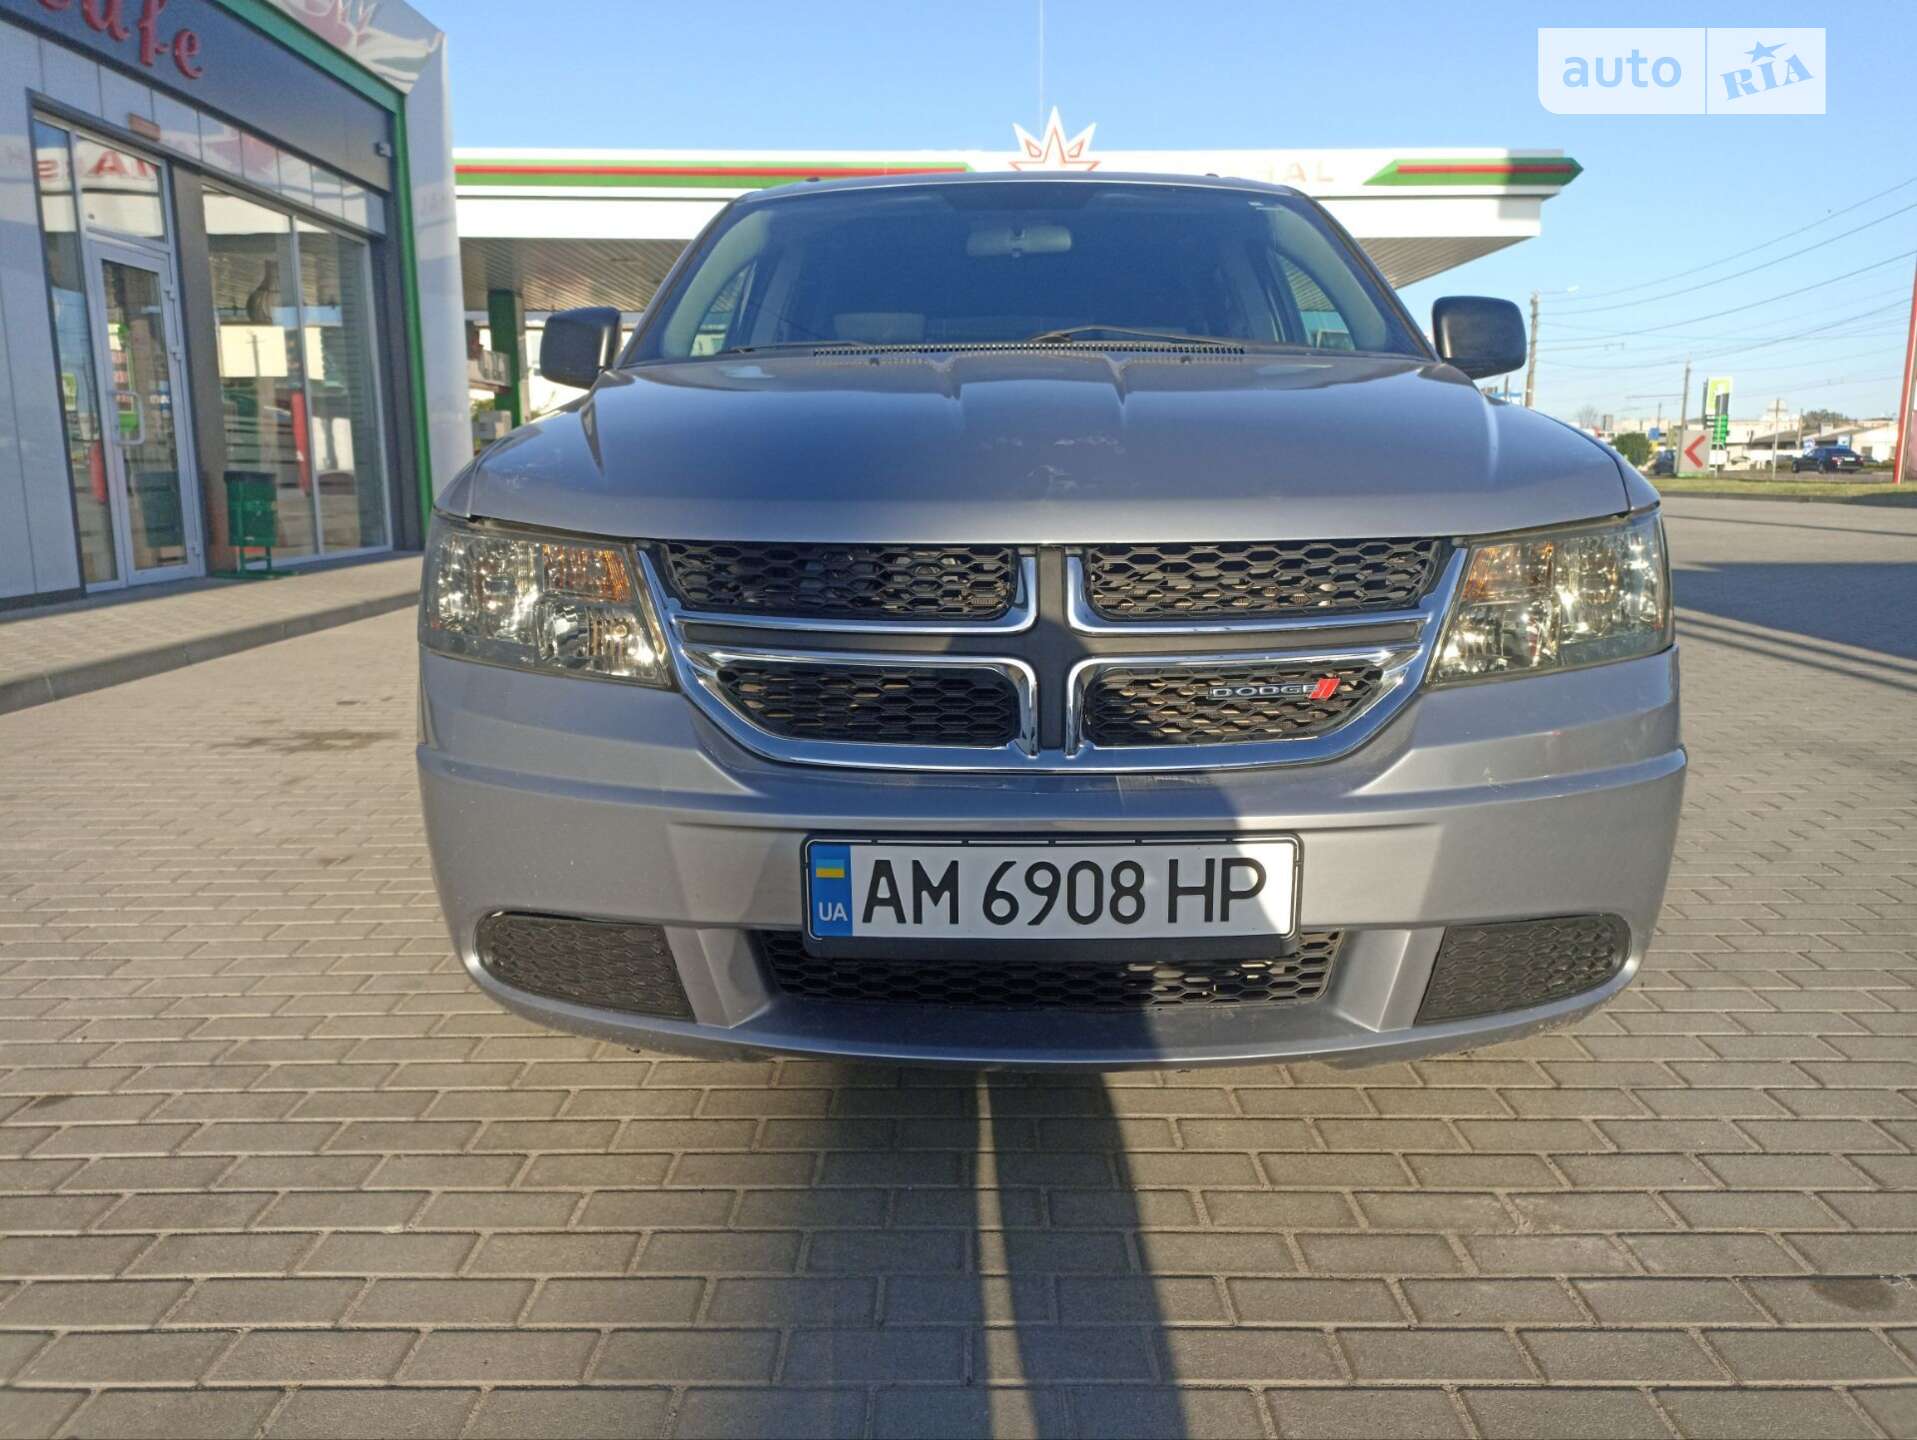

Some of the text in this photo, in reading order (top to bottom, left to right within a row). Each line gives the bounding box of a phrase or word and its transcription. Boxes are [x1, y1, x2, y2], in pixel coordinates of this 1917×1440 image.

[38, 0, 204, 80] afe
[818, 903, 848, 922] UA
[861, 857, 1268, 926] AM 6908 HP
